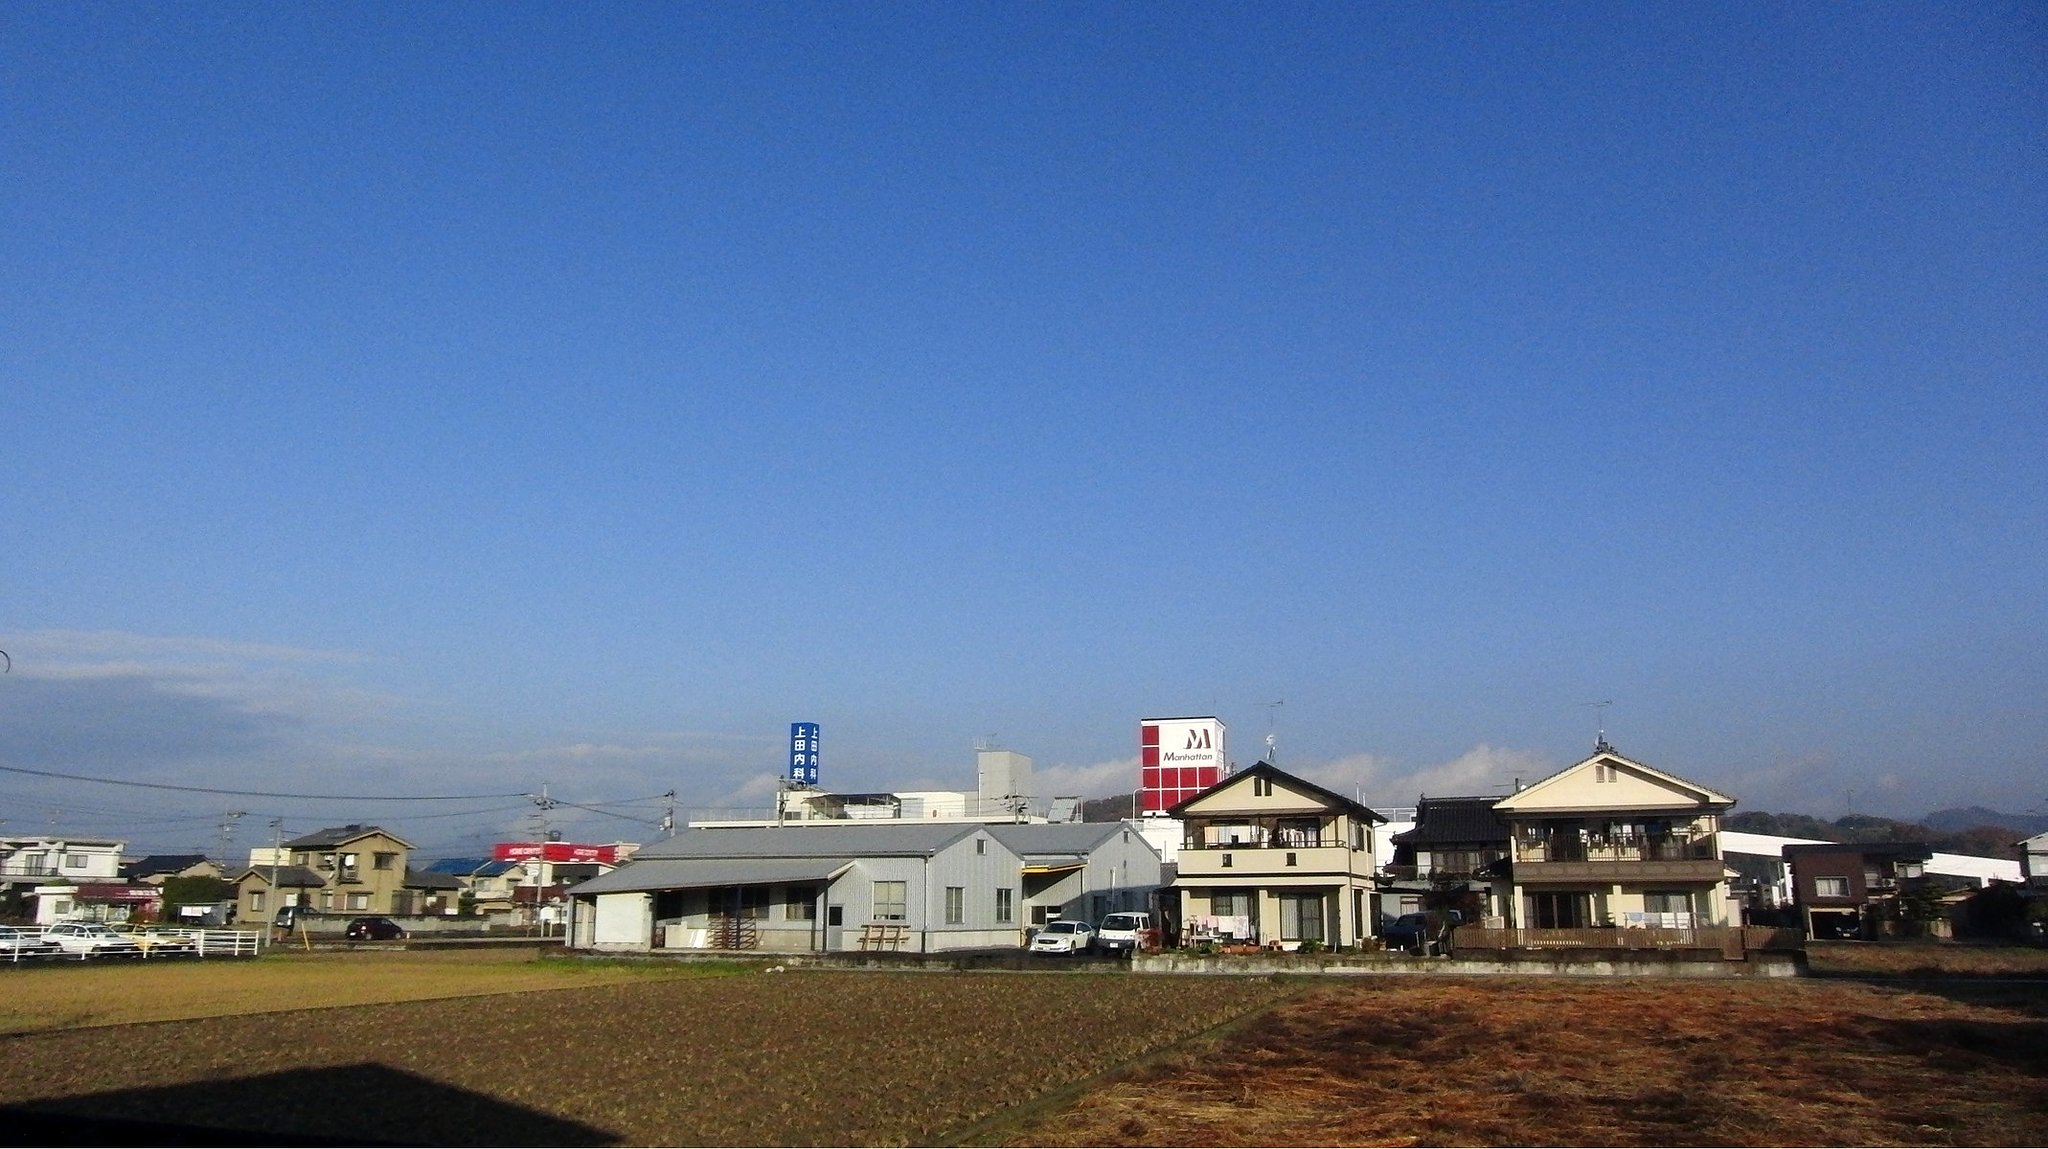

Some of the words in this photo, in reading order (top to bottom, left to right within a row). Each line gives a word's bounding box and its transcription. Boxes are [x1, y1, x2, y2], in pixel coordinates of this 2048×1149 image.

[793, 726, 806, 779] 上田内科
[810, 727, 818, 780] 上田内科
[1163, 752, 1213, 762] Manhattan
